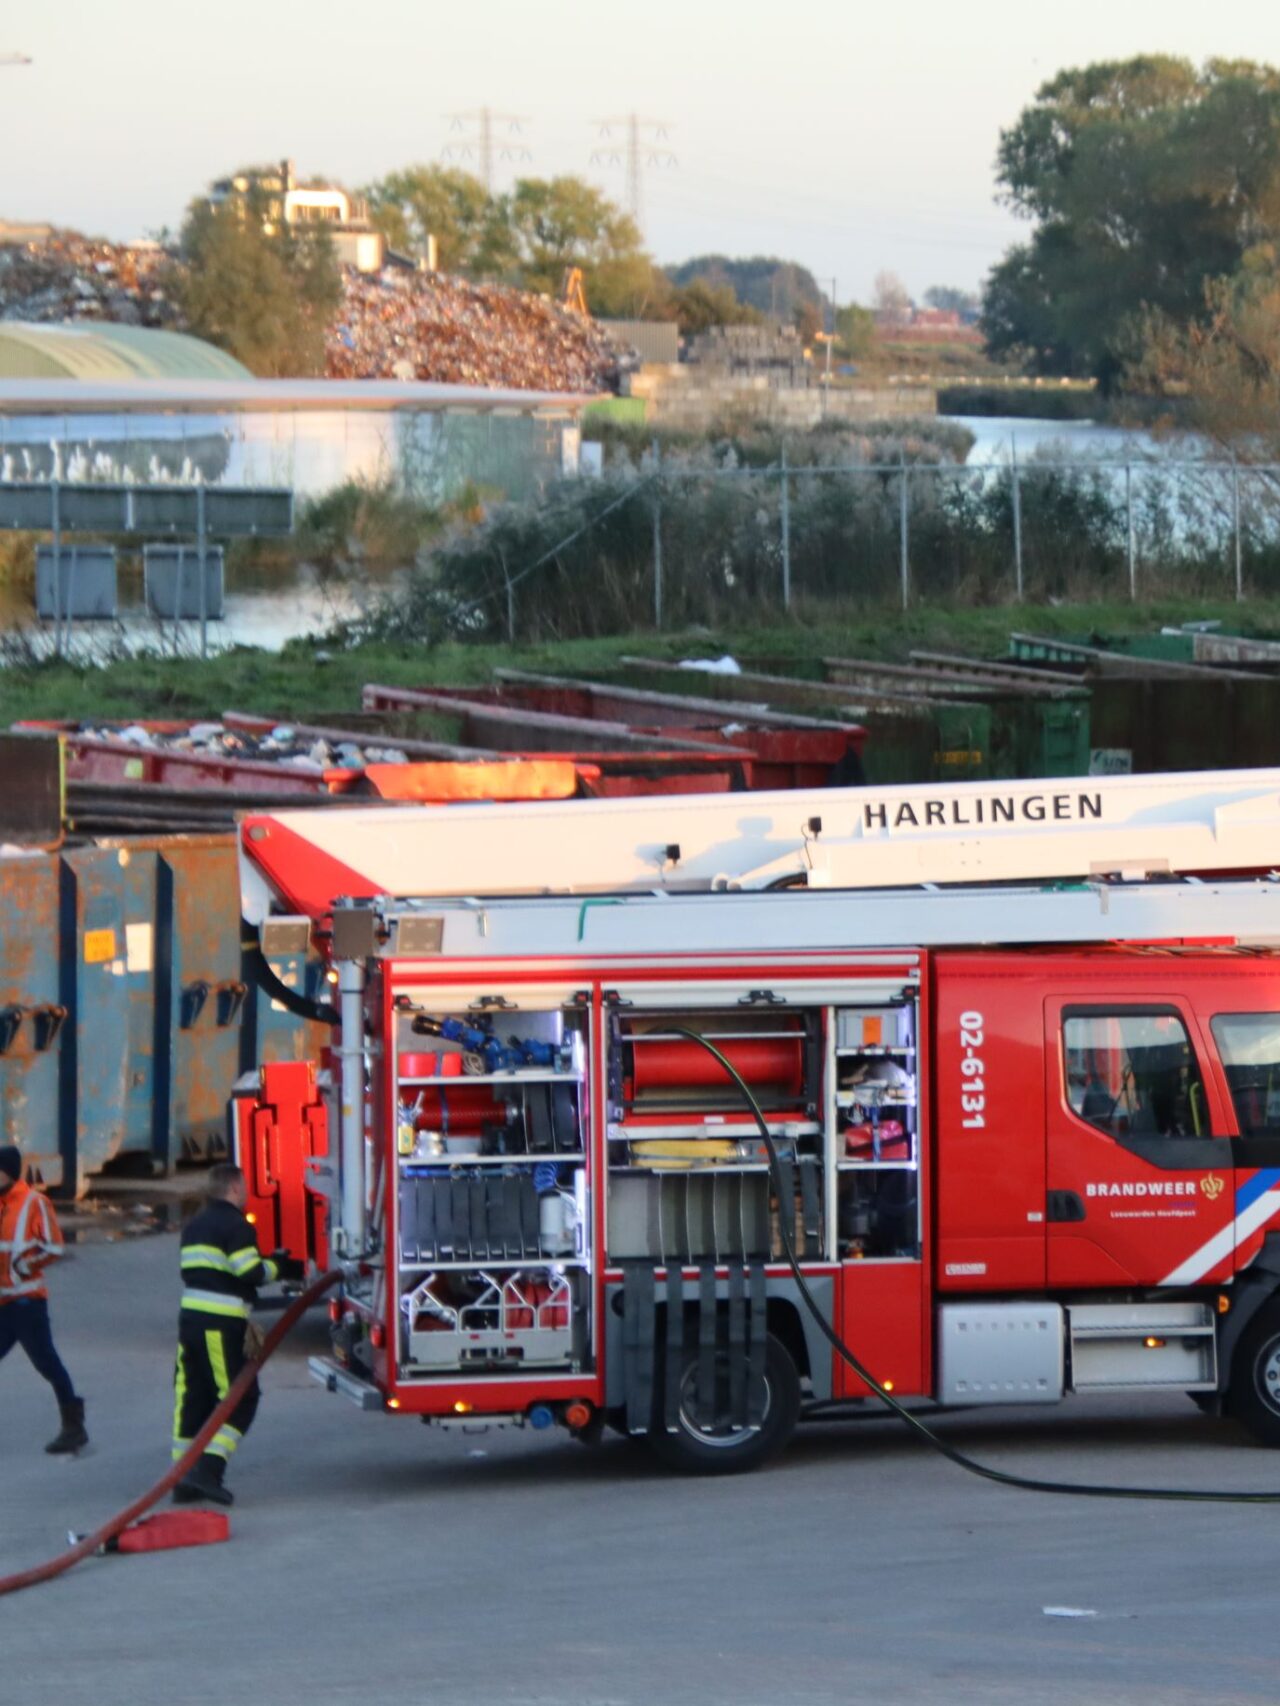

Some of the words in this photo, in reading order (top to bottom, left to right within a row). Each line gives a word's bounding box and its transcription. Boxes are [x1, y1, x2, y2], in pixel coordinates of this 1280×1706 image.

[863, 793, 1102, 828] HARLINGEN
[959, 1011, 986, 1128] 02-6131
[1085, 1181, 1196, 1197] BRANDWEER
